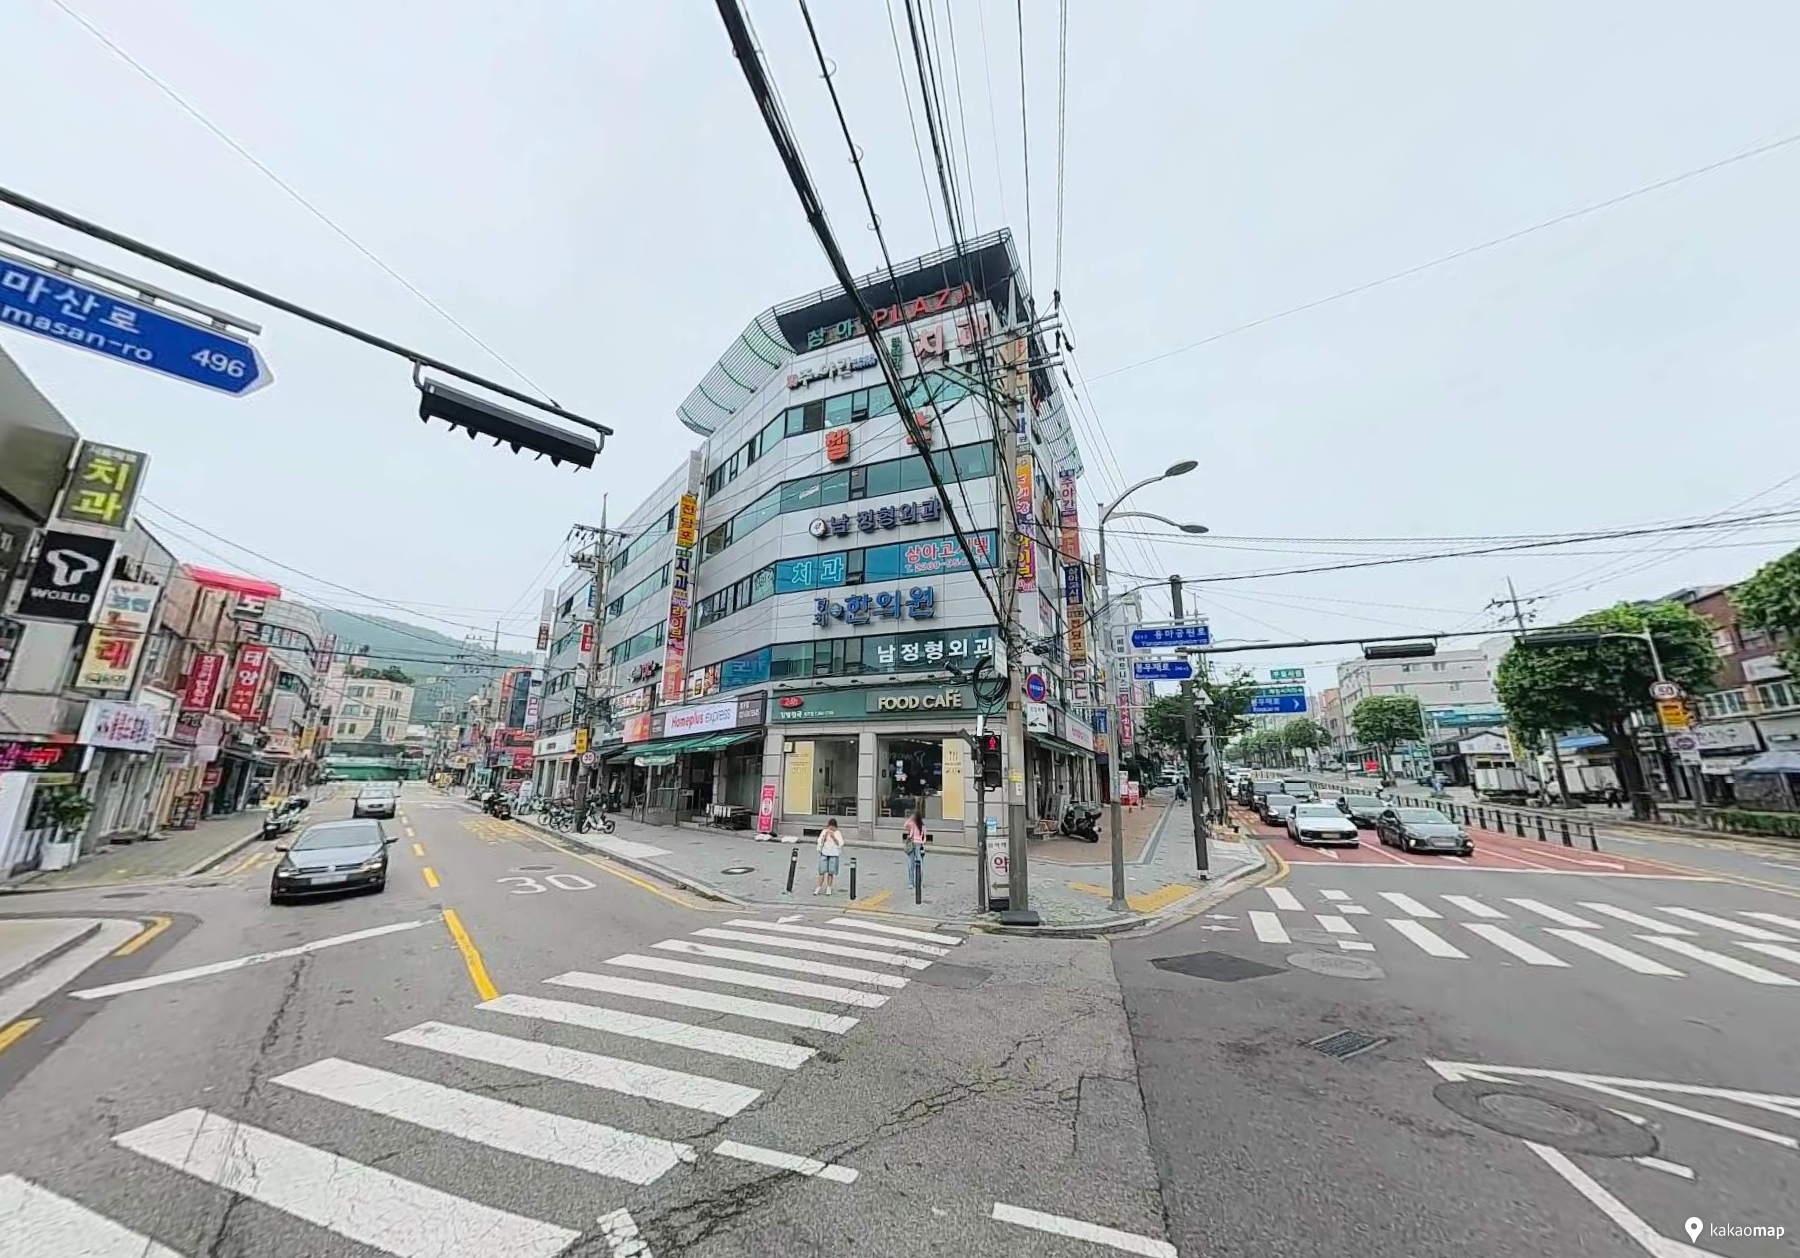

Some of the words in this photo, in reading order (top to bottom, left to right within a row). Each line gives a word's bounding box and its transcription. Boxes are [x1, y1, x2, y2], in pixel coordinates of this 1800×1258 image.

[1, 271, 139, 334] 마산로
[1, 305, 153, 361] masan-ro
[191, 349, 246, 378] 496
[72, 458, 130, 521] 치과
[830, 499, 941, 535] 남정형외과
[675, 557, 689, 591] 치과
[791, 557, 844, 586] 치과
[30, 587, 90, 604] WORLD
[844, 586, 934, 625] 한의원
[1153, 627, 1206, 640] 용마공원로
[878, 637, 993, 665] 남정형외과
[240, 651, 264, 686] 태양
[878, 695, 920, 710] FOOD
[671, 709, 704, 730] Homeplus
[705, 708, 732, 725] express
[497, 873, 597, 894] 30
